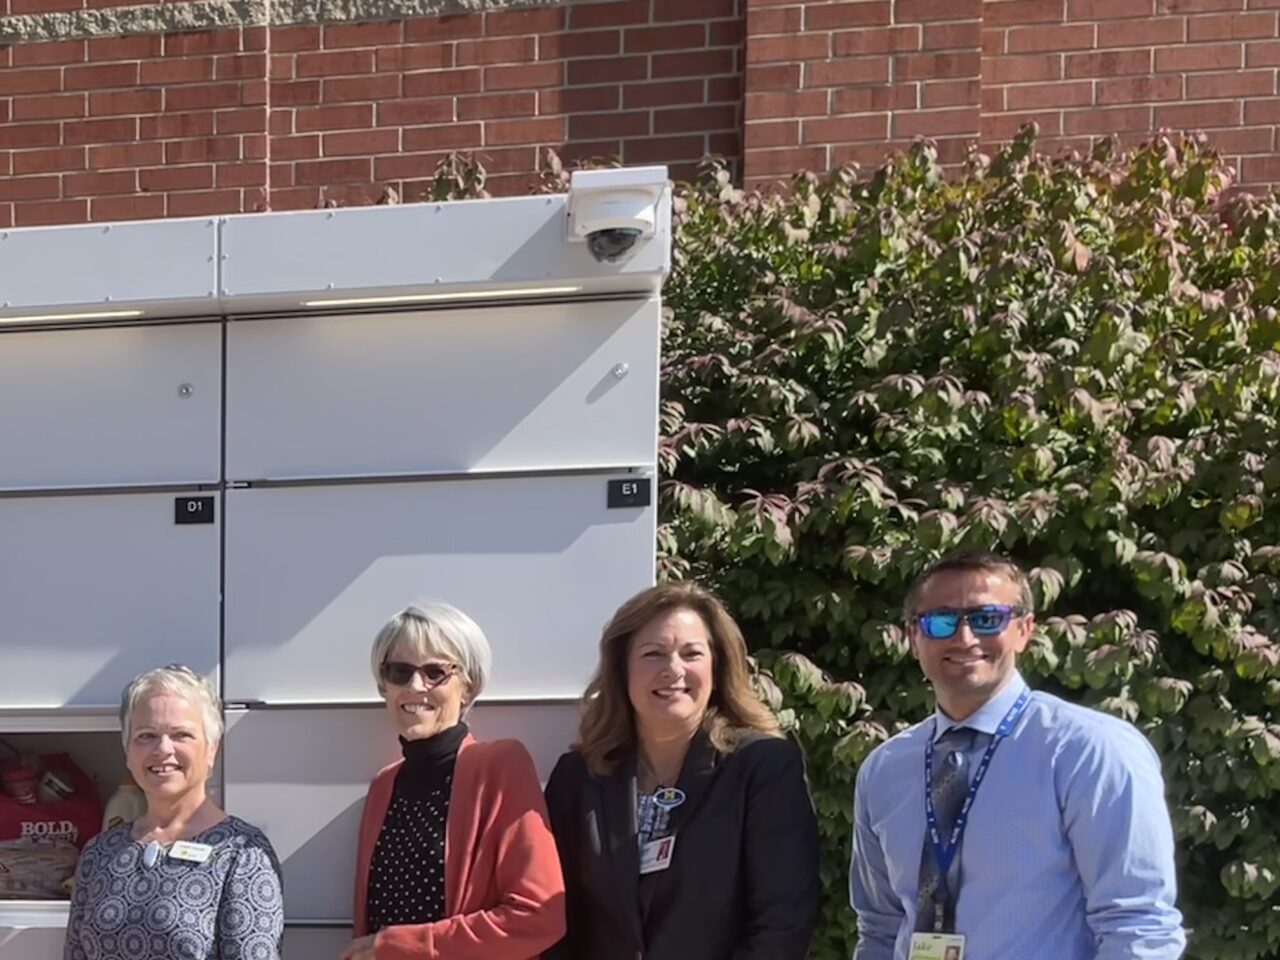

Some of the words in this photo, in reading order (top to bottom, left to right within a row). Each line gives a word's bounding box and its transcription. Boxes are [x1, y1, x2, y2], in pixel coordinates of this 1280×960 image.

[622, 483, 638, 495] E1
[187, 500, 203, 512] D1
[20, 820, 74, 836] BOLD
